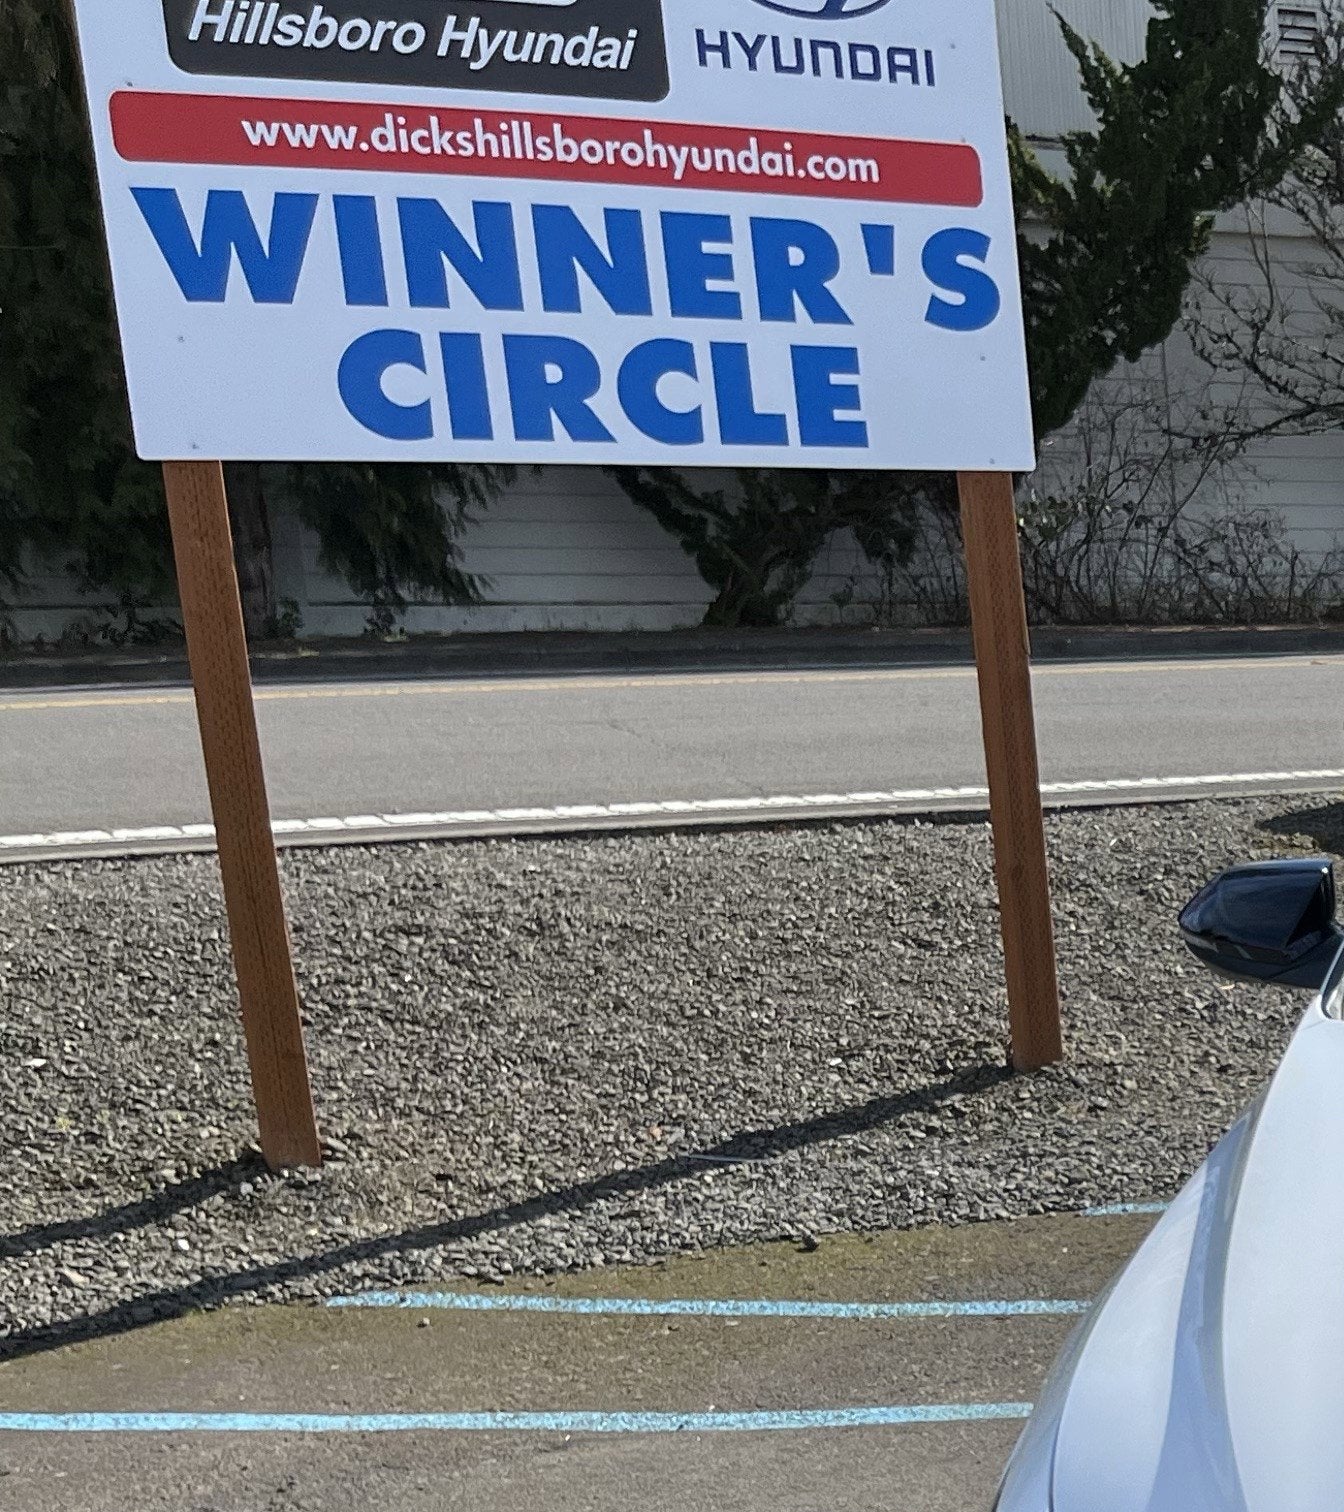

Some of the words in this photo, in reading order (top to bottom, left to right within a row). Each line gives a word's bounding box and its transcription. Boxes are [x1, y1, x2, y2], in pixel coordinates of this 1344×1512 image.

[188, 0, 426, 54] Hillsboro
[437, 15, 638, 71] Hyundai
[695, 28, 936, 87] HYUNDAI
[241, 113, 880, 183] www.dickshillsborohyundai.com
[129, 187, 1001, 332] WINNER'S
[337, 329, 869, 448] CIRCLE
